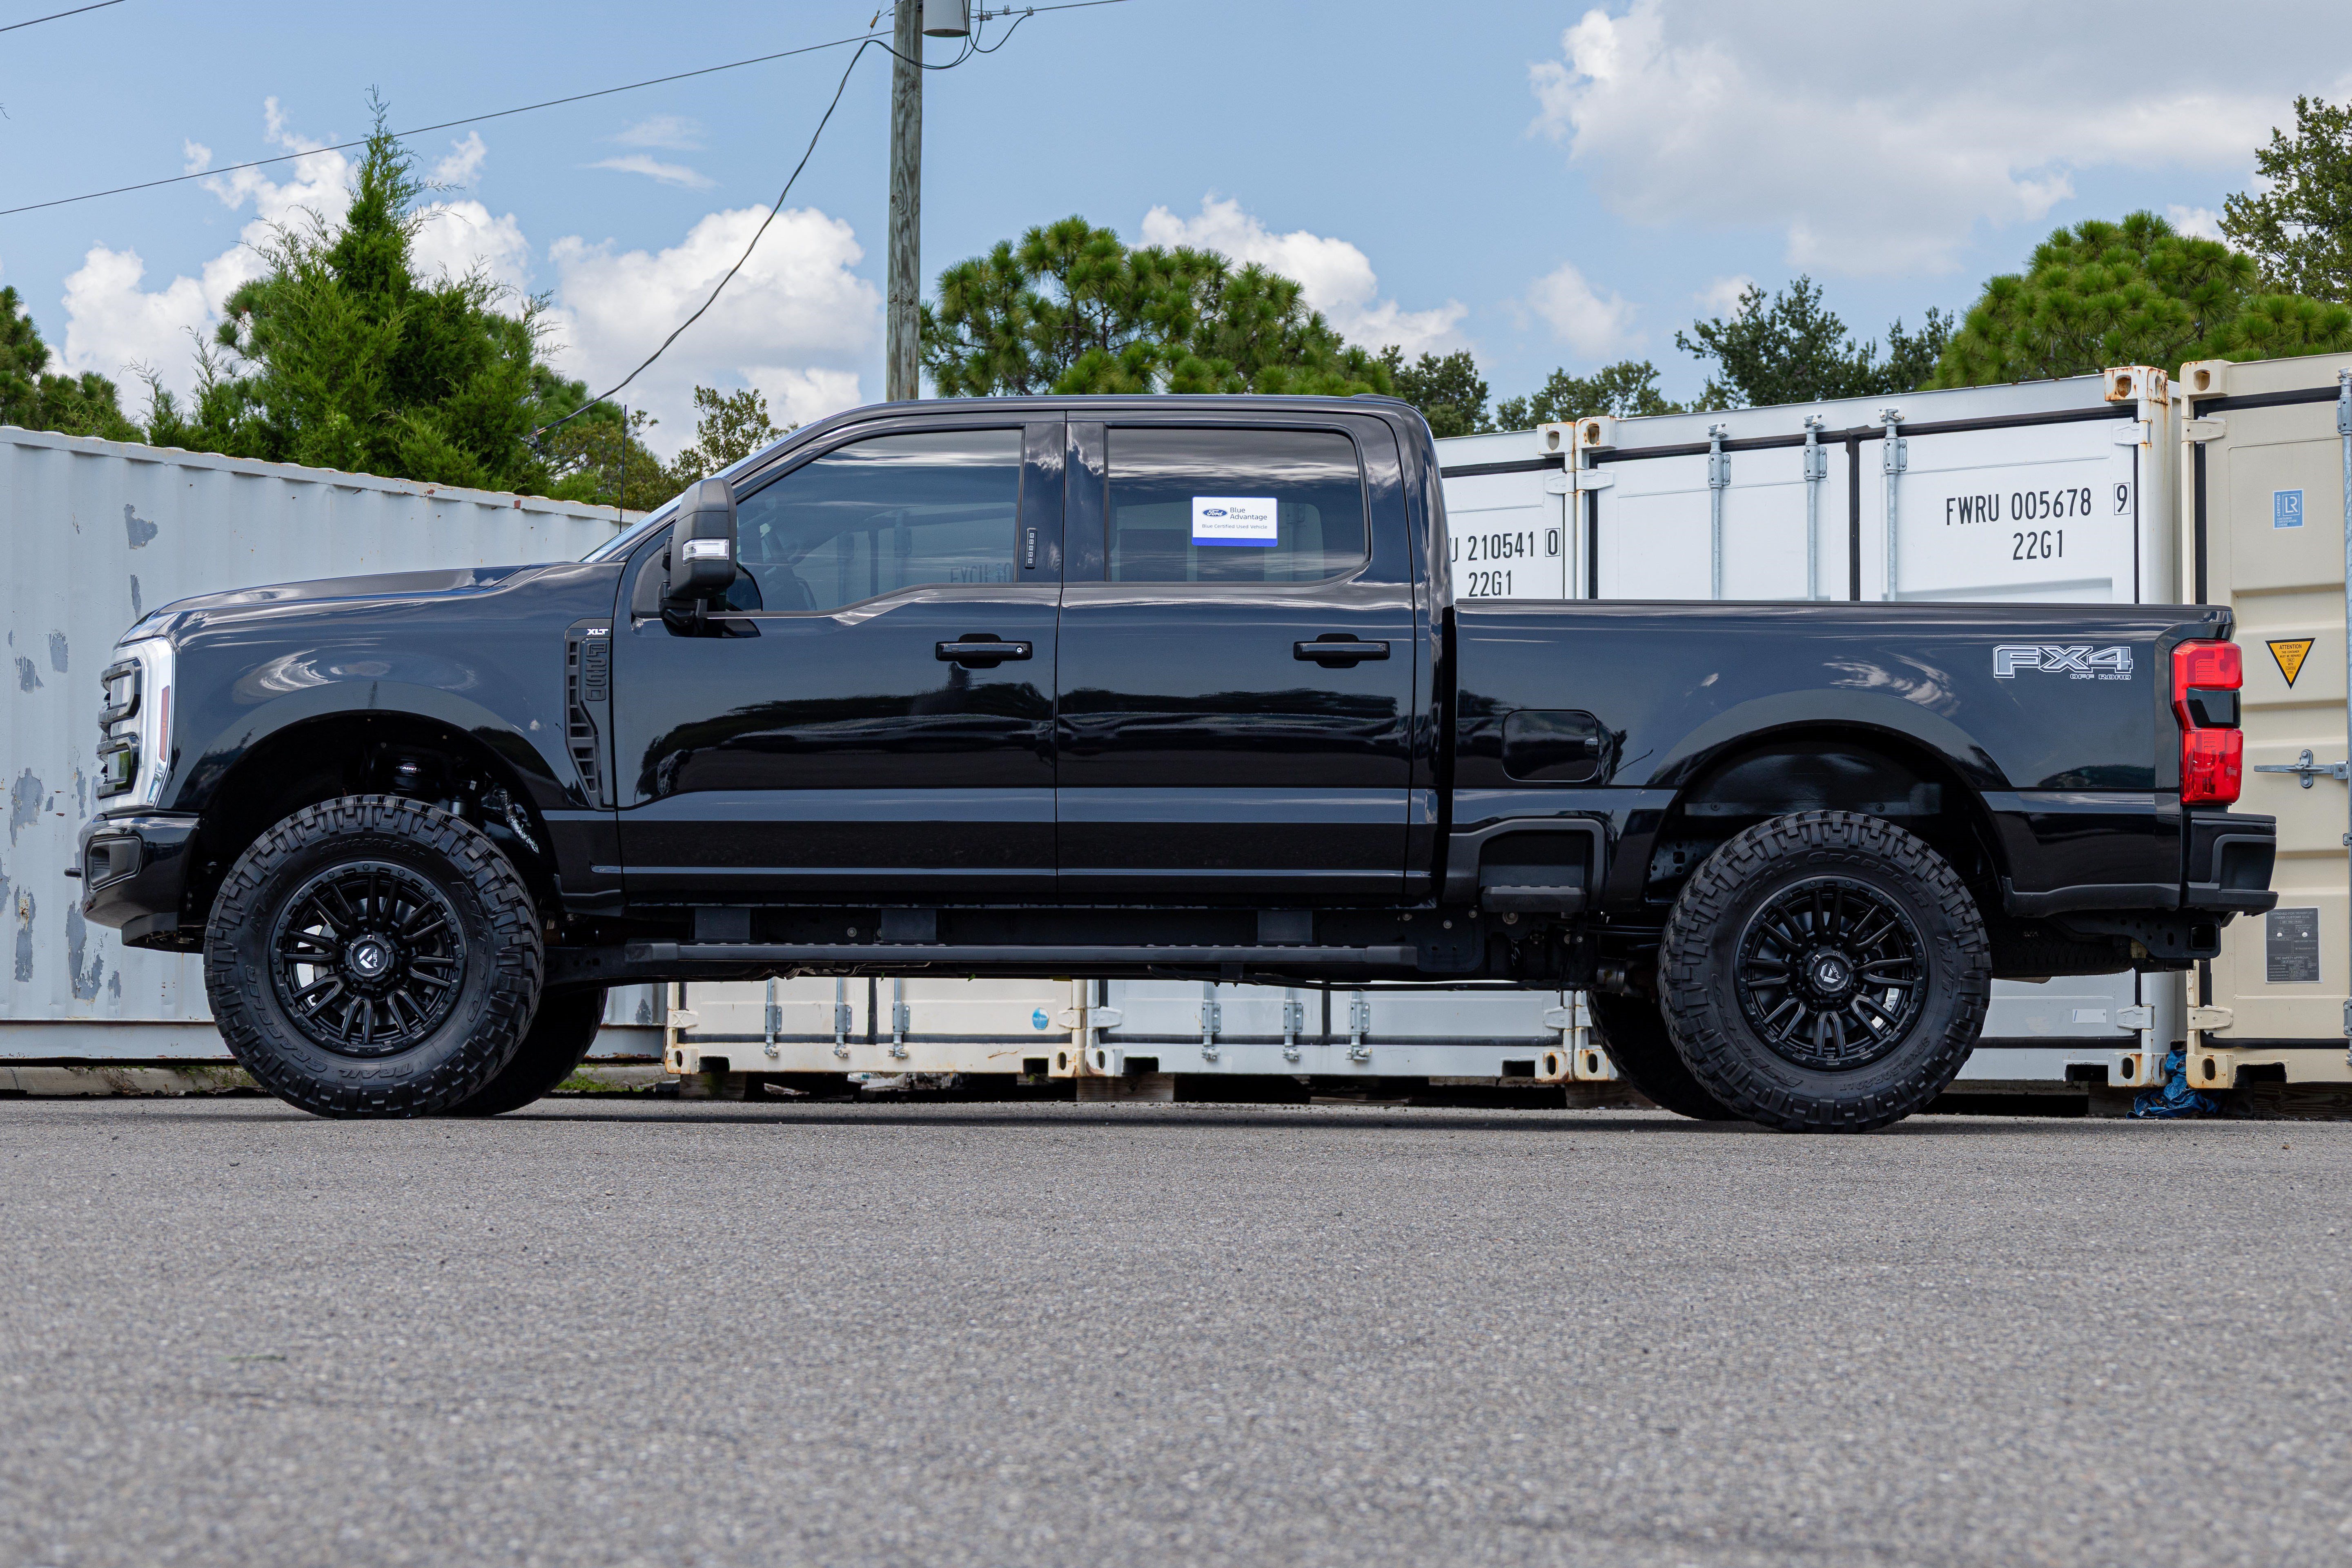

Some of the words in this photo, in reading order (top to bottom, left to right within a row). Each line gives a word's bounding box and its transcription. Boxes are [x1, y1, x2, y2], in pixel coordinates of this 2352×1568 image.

[1946, 493, 1999, 526] FWRU
[2011, 488, 2091, 520] 005678
[2116, 484, 2128, 513] 9
[2285, 497, 2298, 513] LR
[1468, 531, 1534, 561] 210541
[1548, 530, 1557, 555] 0
[2013, 530, 2062, 560] 22G1
[1468, 570, 1512, 597] 22G1
[1993, 645, 2133, 678] FX4
[1831, 962, 1841, 979] FUEL
[246, 965, 327, 1072] GRAPPLER
[339, 1064, 413, 1079] TRAIL
